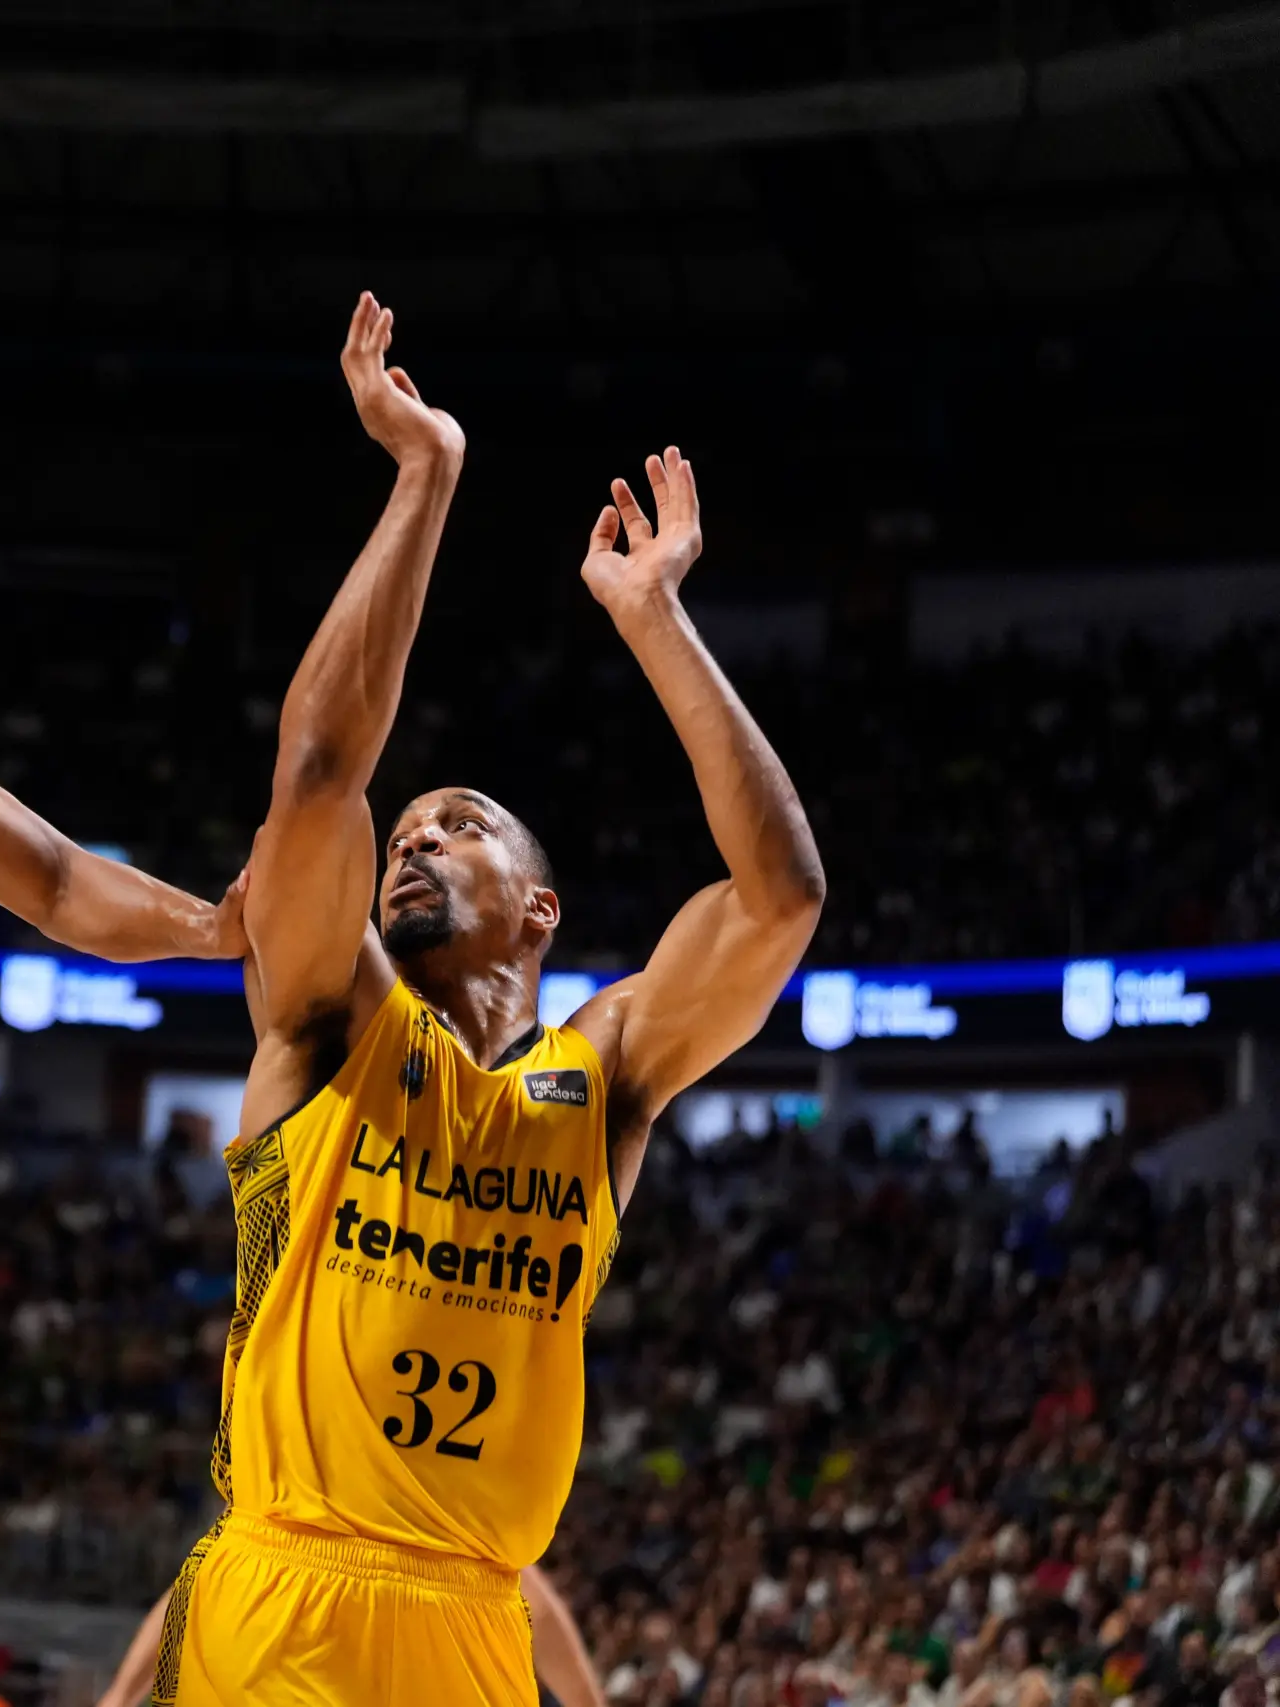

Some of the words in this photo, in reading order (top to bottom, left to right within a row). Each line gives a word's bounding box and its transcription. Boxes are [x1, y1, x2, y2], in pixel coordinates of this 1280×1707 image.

[350, 1123, 405, 1184] LA
[415, 1150, 588, 1225] LAGUNA
[326, 1253, 431, 1299] despierta
[442, 1289, 544, 1322] emociones
[383, 1349, 496, 1461] 32
